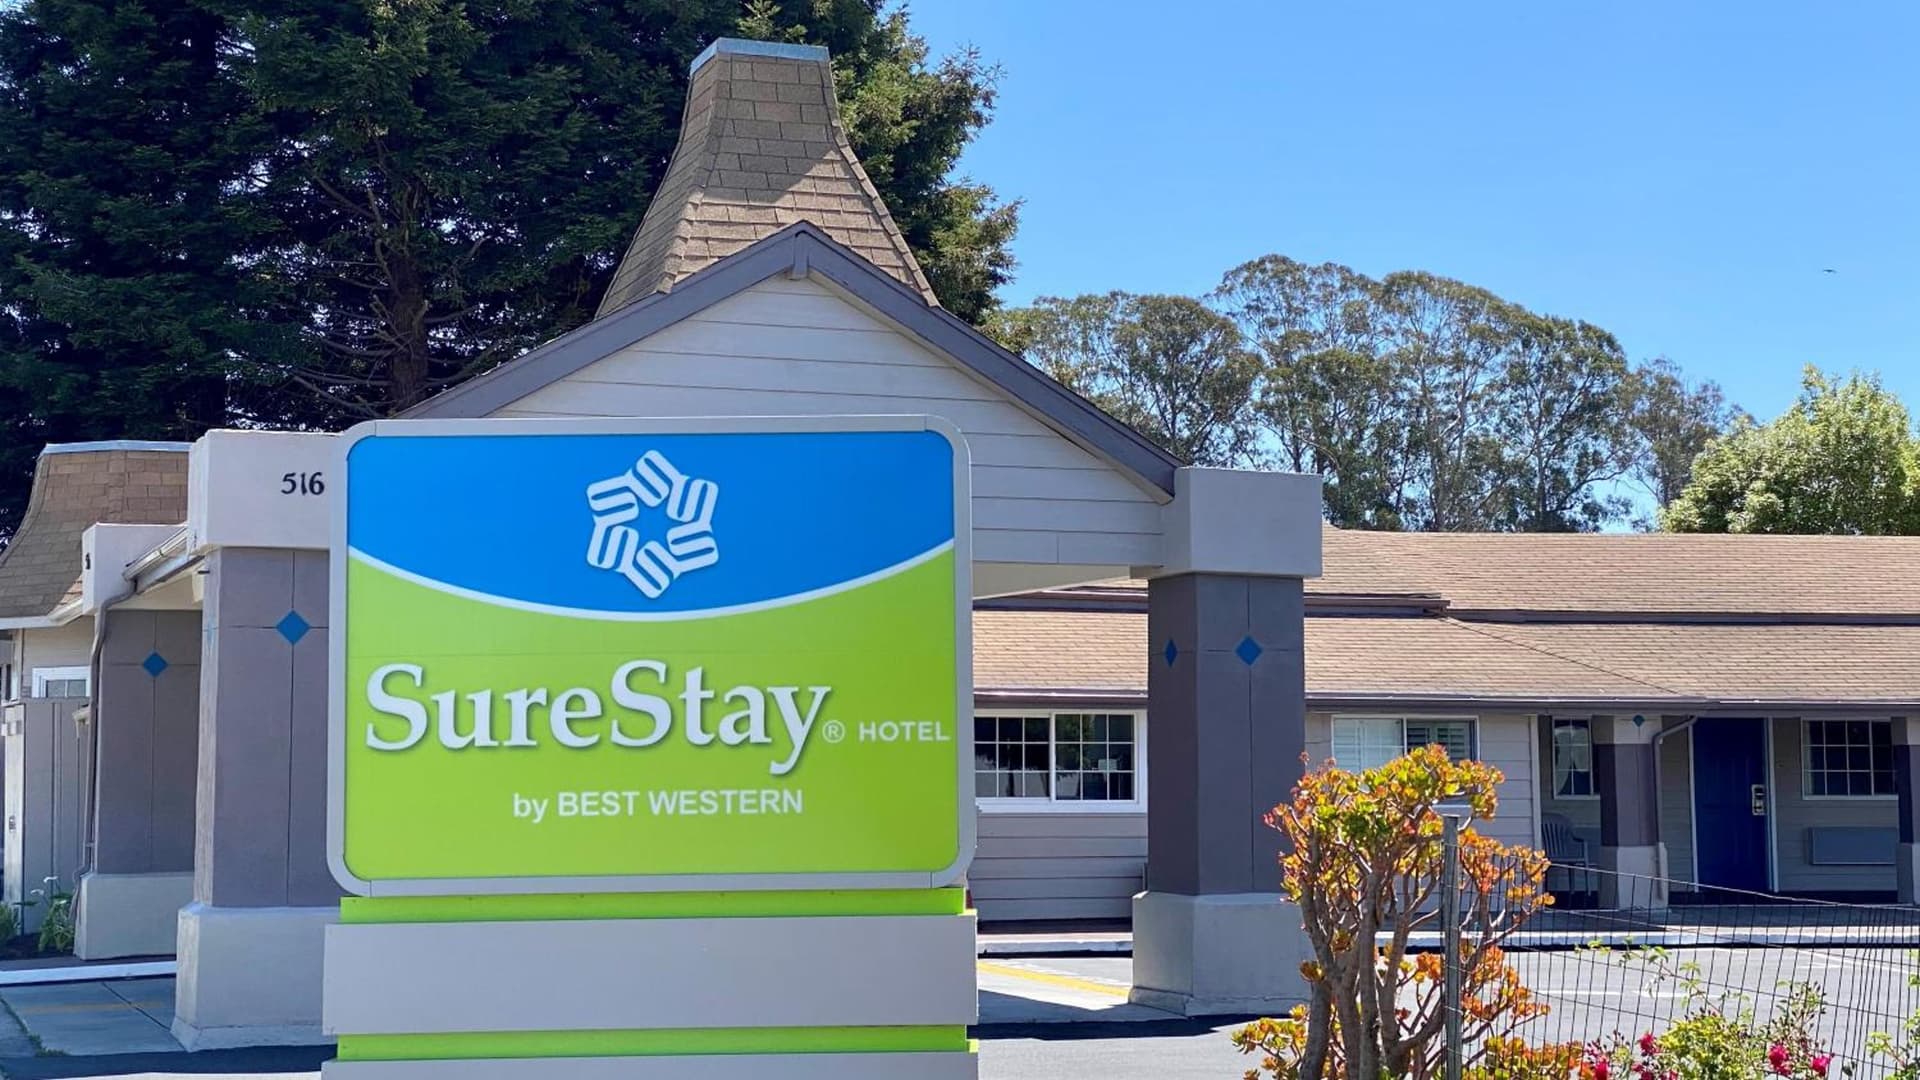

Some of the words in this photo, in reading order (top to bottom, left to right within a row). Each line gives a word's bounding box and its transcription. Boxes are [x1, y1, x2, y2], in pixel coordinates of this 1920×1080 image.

[281, 472, 325, 496] 516
[859, 721, 950, 742] HOTEL
[512, 793, 549, 824] by
[558, 791, 640, 816] BEST
[648, 789, 804, 816] WESTERN
